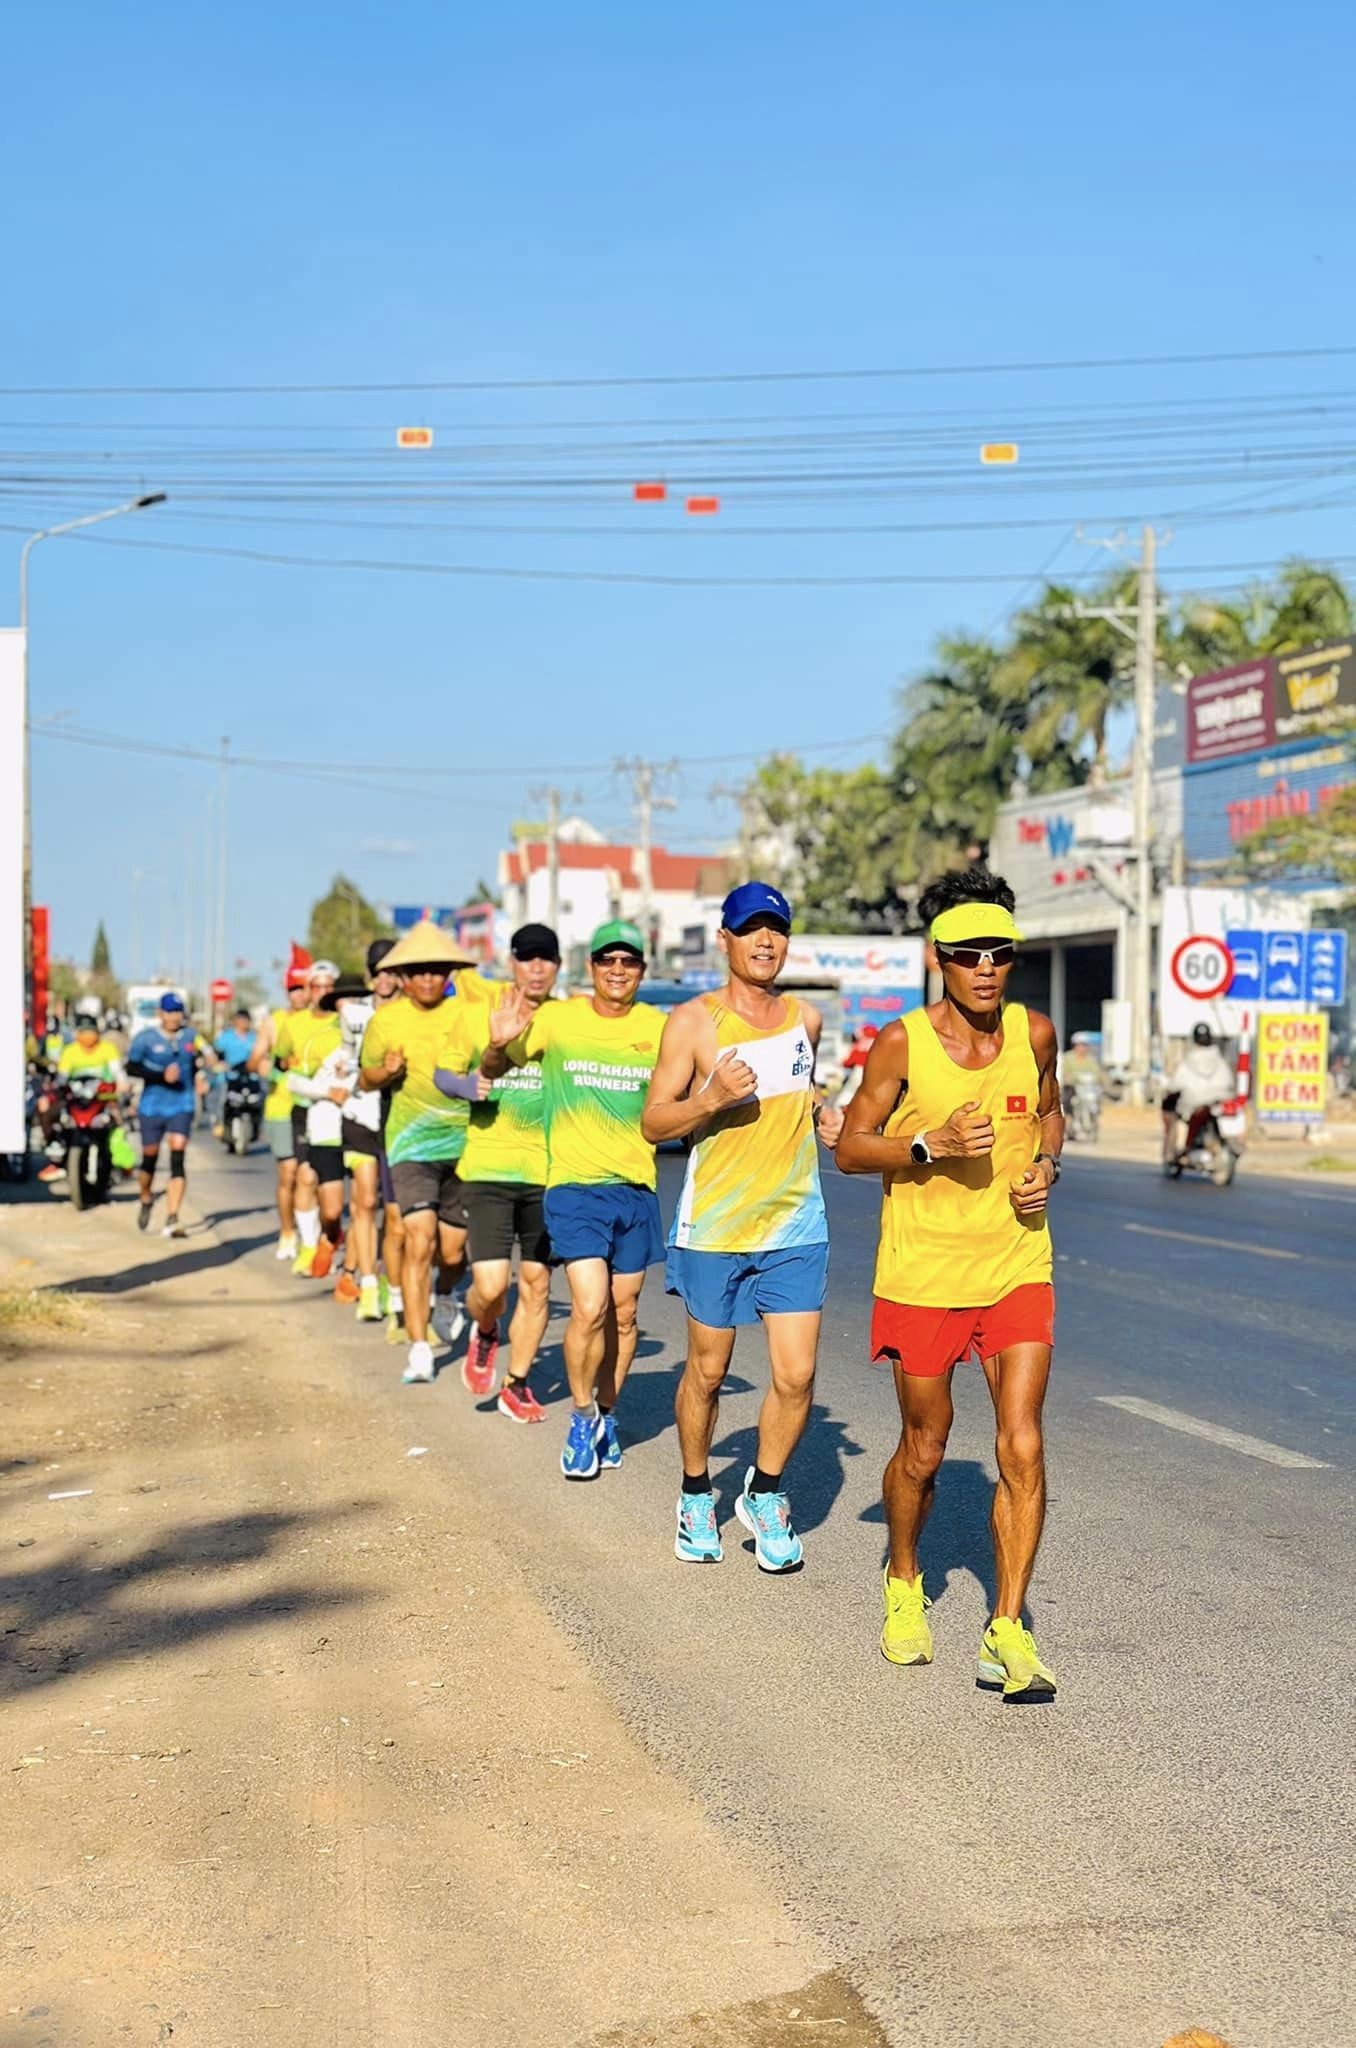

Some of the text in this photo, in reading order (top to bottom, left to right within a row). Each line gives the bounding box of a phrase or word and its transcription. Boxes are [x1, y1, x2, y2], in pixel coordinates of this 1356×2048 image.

[1185, 953, 1220, 980] 60
[563, 1060, 598, 1073] LONG
[573, 1075, 640, 1092] RUNNERS
